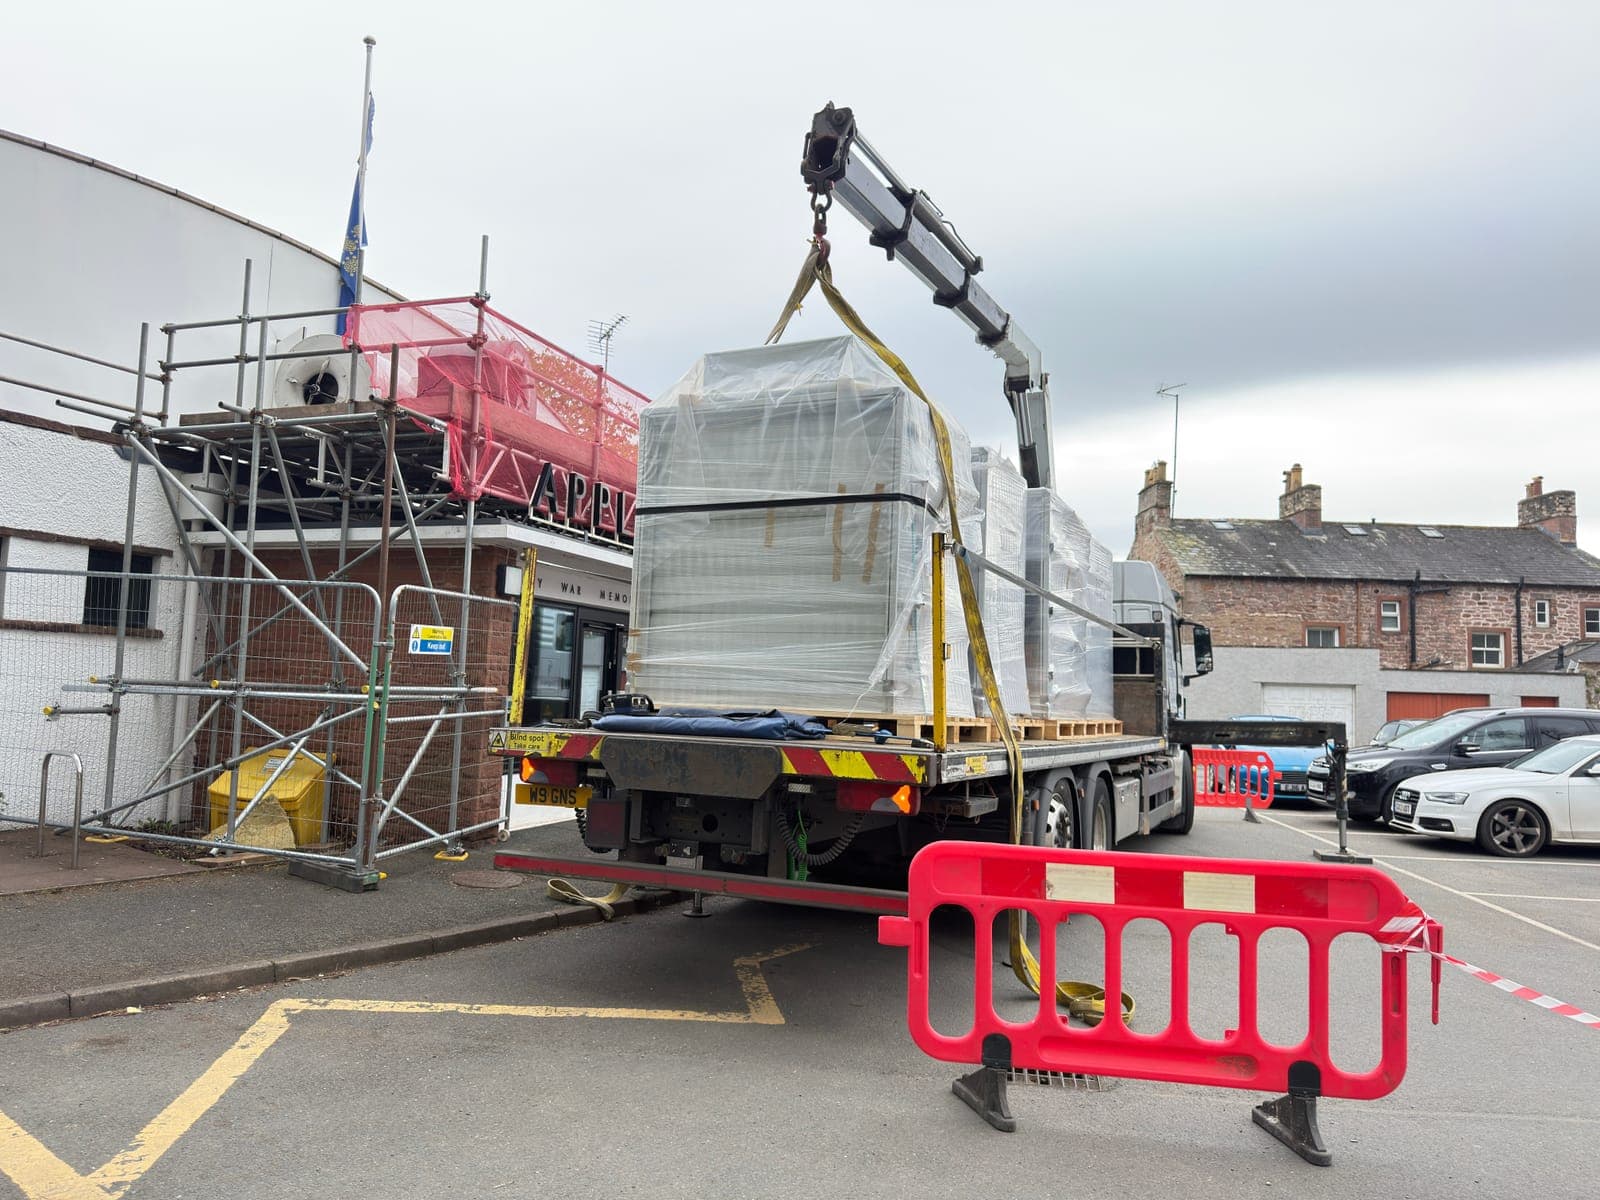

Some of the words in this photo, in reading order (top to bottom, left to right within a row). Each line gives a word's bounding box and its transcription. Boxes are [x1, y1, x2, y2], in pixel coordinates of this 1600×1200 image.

[561, 582, 582, 596] WAR
[600, 590, 632, 604] MEMO
[510, 733, 527, 741] Blind
[528, 735, 545, 743] spot
[529, 787, 547, 803] W9
[551, 788, 577, 805] GNS
